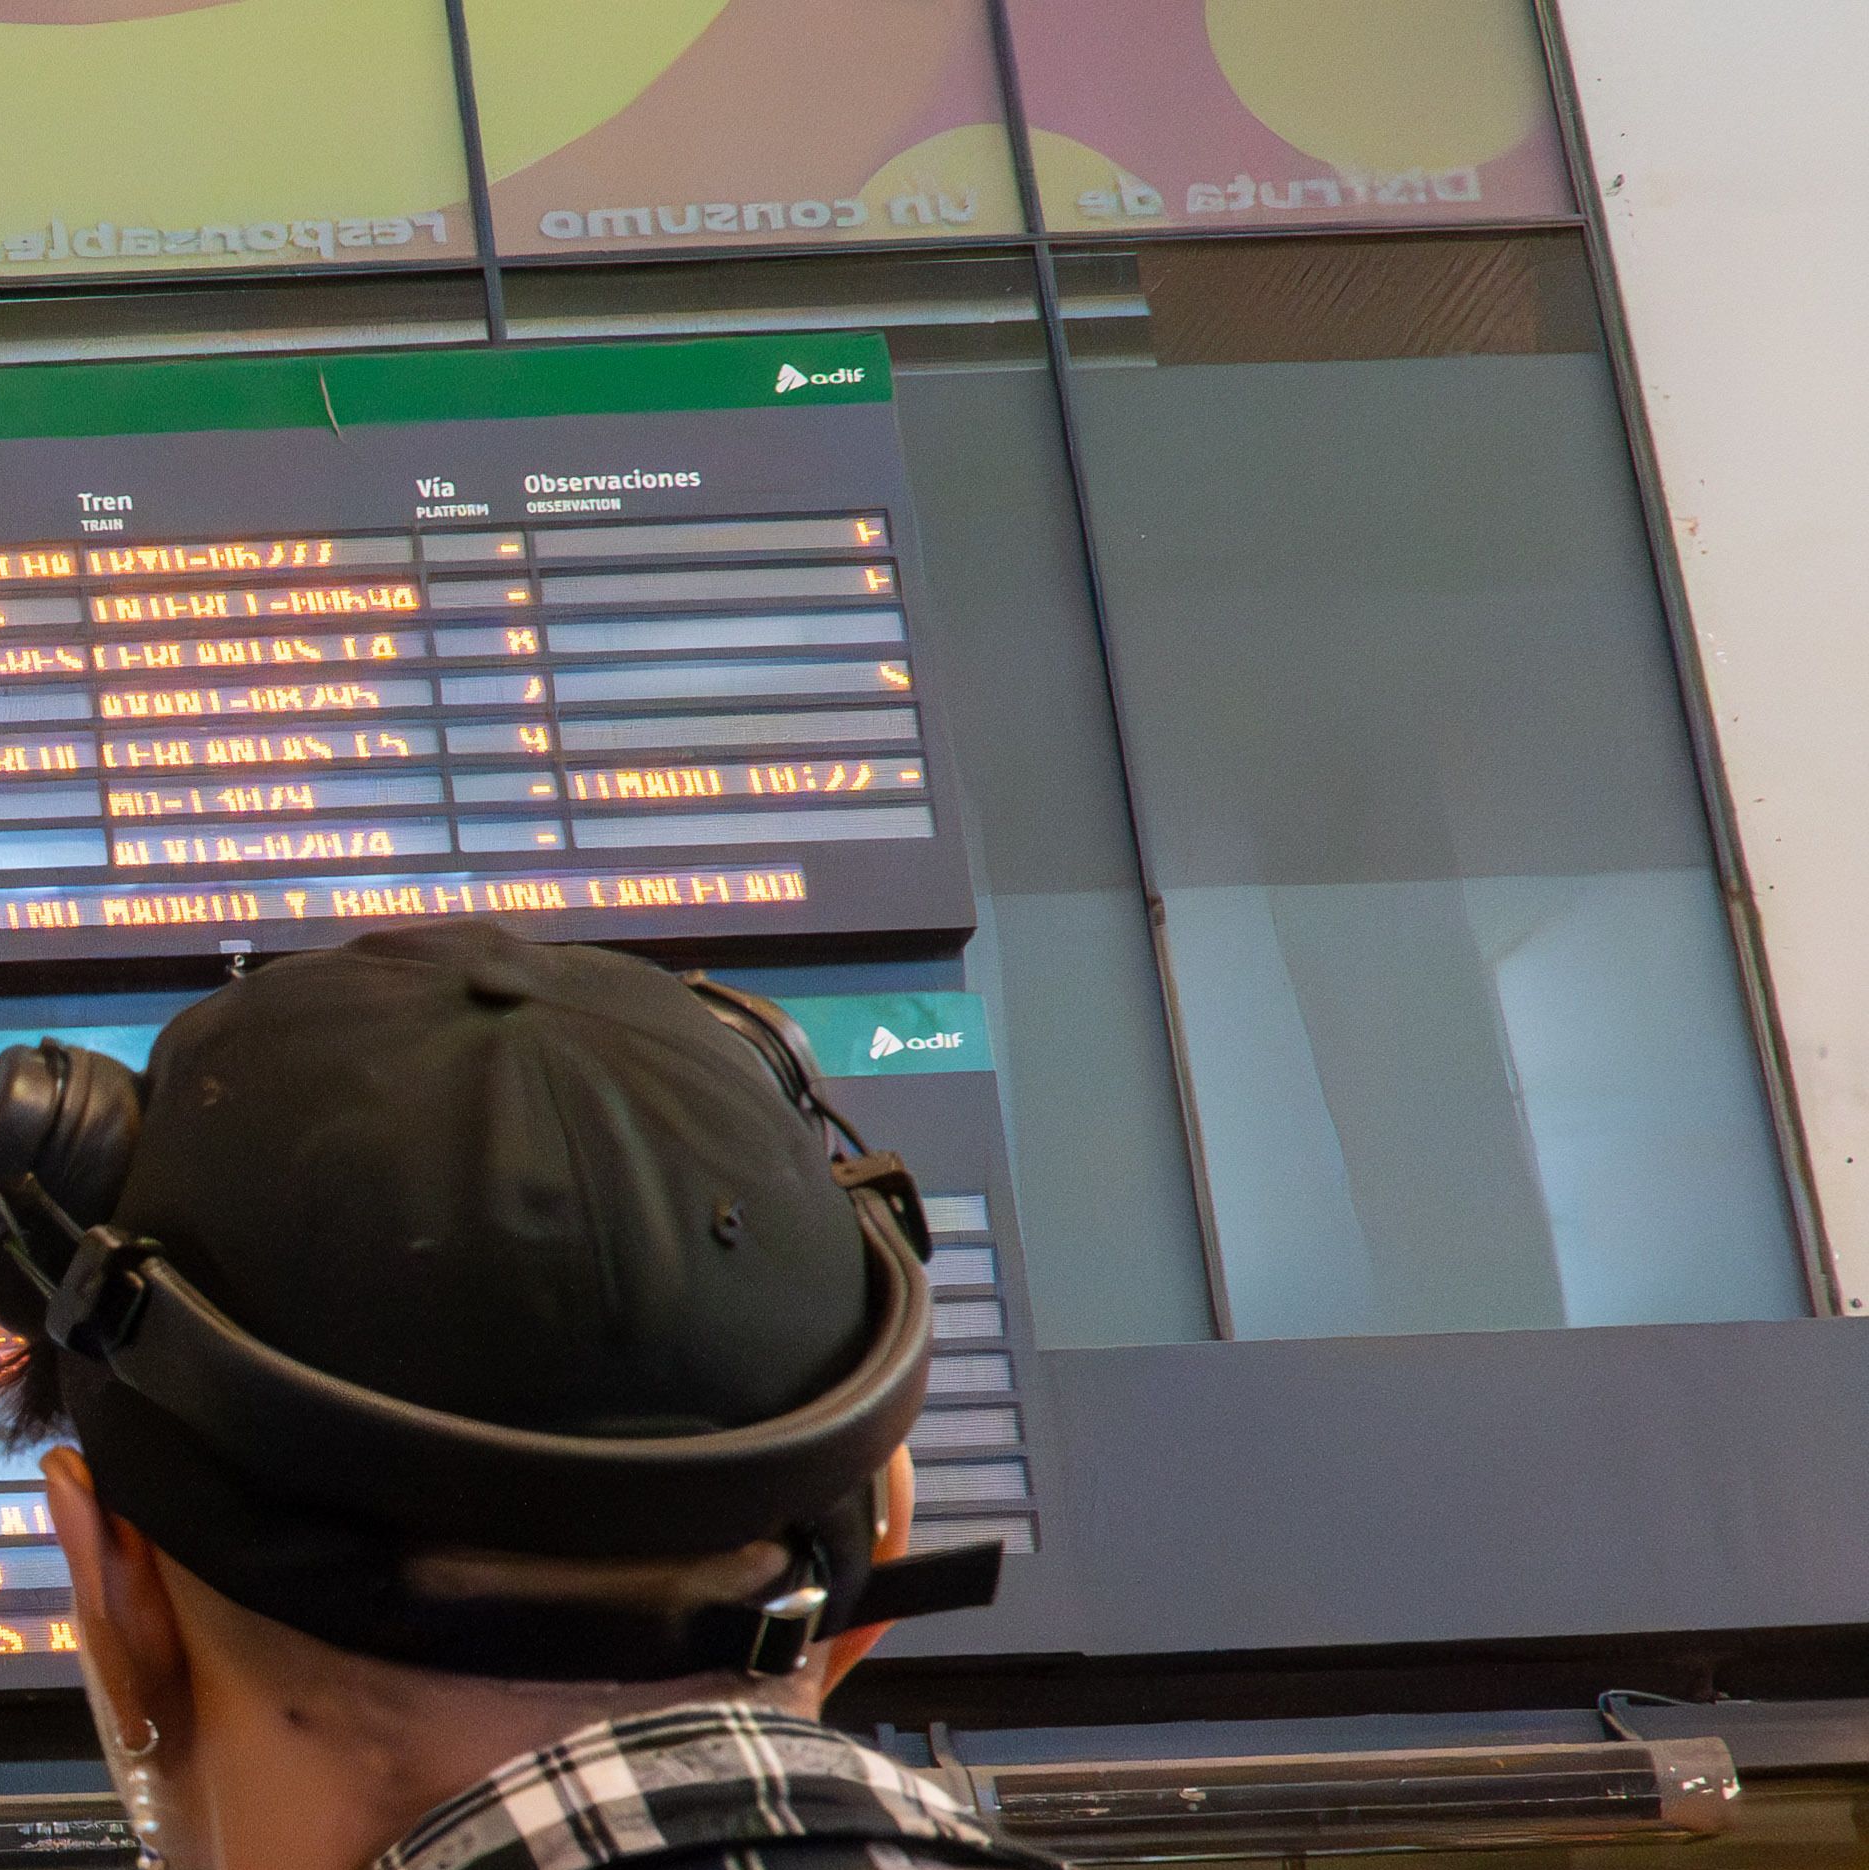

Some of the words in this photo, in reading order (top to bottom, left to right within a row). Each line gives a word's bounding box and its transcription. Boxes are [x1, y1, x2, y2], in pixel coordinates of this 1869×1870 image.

[810, 366, 865, 386] adif
[416, 478, 455, 499] Vía
[525, 469, 701, 495] Observaciones
[78, 493, 133, 512] Tren
[416, 503, 489, 519] PLATFORM
[81, 518, 124, 531] TRAIN
[906, 1031, 964, 1051] adif
